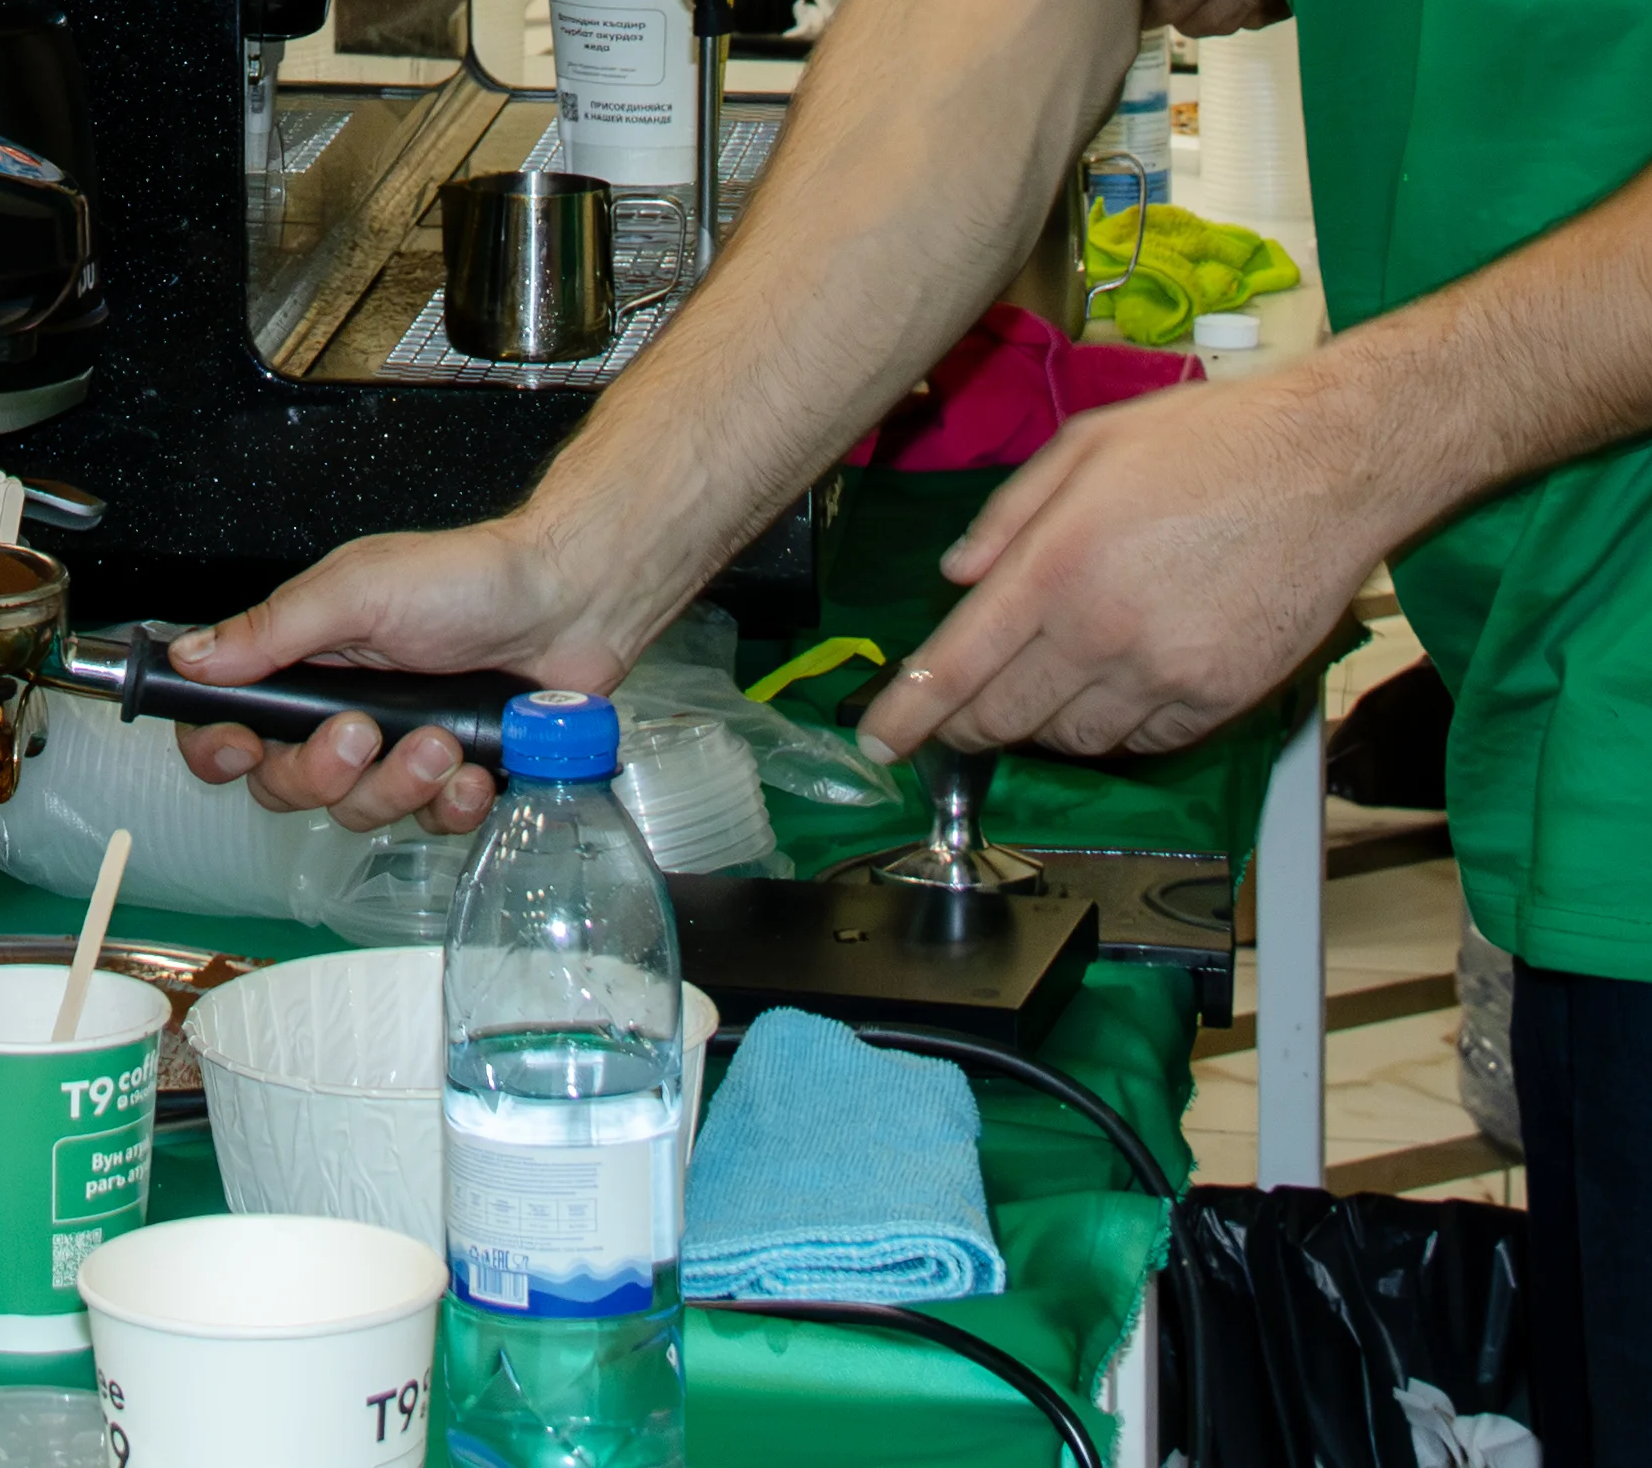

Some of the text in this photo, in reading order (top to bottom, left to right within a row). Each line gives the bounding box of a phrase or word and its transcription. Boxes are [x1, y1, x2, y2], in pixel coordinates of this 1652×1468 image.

[590, 99, 673, 113] ПРИСОЕДИНЯЙСЯ
[590, 112, 624, 124] НАШЕЙ
[625, 115, 672, 125] КОМАНДЕ
[60, 1075, 114, 1119] T9
[92, 1150, 123, 1173] Вун
[366, 1377, 419, 1442] T9
